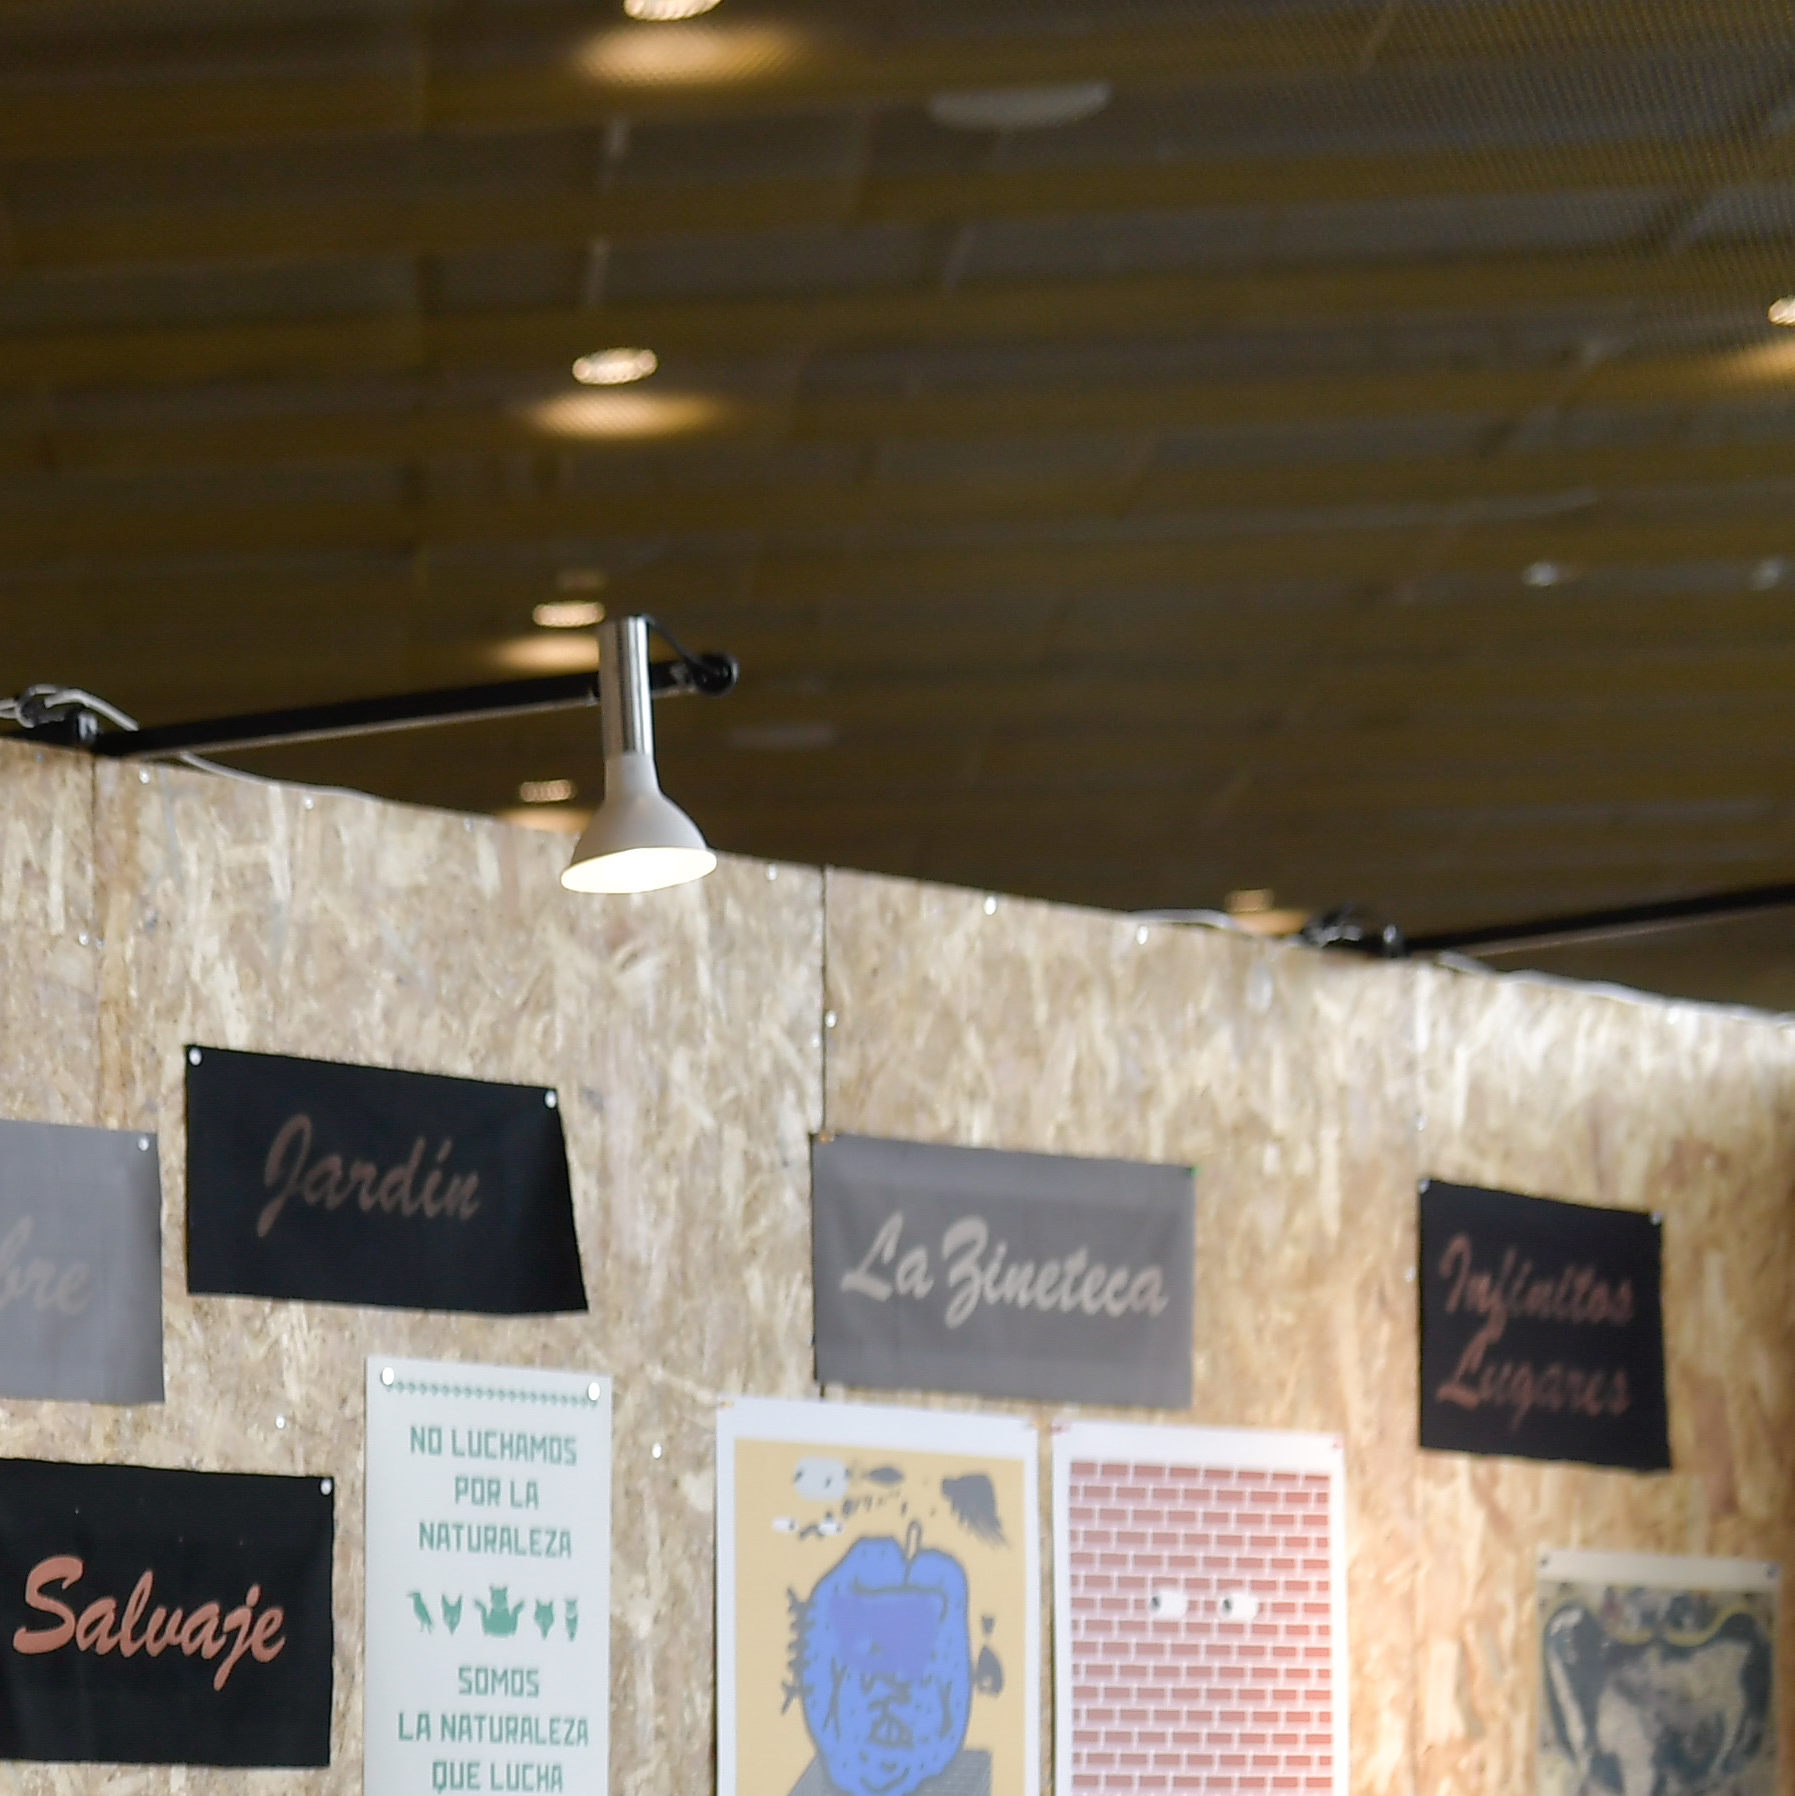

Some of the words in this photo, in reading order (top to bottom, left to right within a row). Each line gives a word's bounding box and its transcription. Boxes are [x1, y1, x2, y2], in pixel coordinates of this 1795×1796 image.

[256, 1112, 483, 1238] Jardín
[841, 1212, 935, 1302] La
[941, 1216, 1170, 1329] Zineteca
[410, 1426, 443, 1455] NO
[451, 1428, 578, 1466] LUCHAMOS
[455, 1476, 501, 1507] POR
[510, 1479, 539, 1510] LA
[419, 1520, 573, 1560] NATURALEZA
[13, 1555, 286, 1691] Salvaje
[458, 1664, 540, 1699] SOMOS
[398, 1712, 432, 1742] LA
[441, 1713, 589, 1748] NATURALEZA
[432, 1759, 481, 1795] QUE
[490, 1763, 564, 1796] LUCHA
